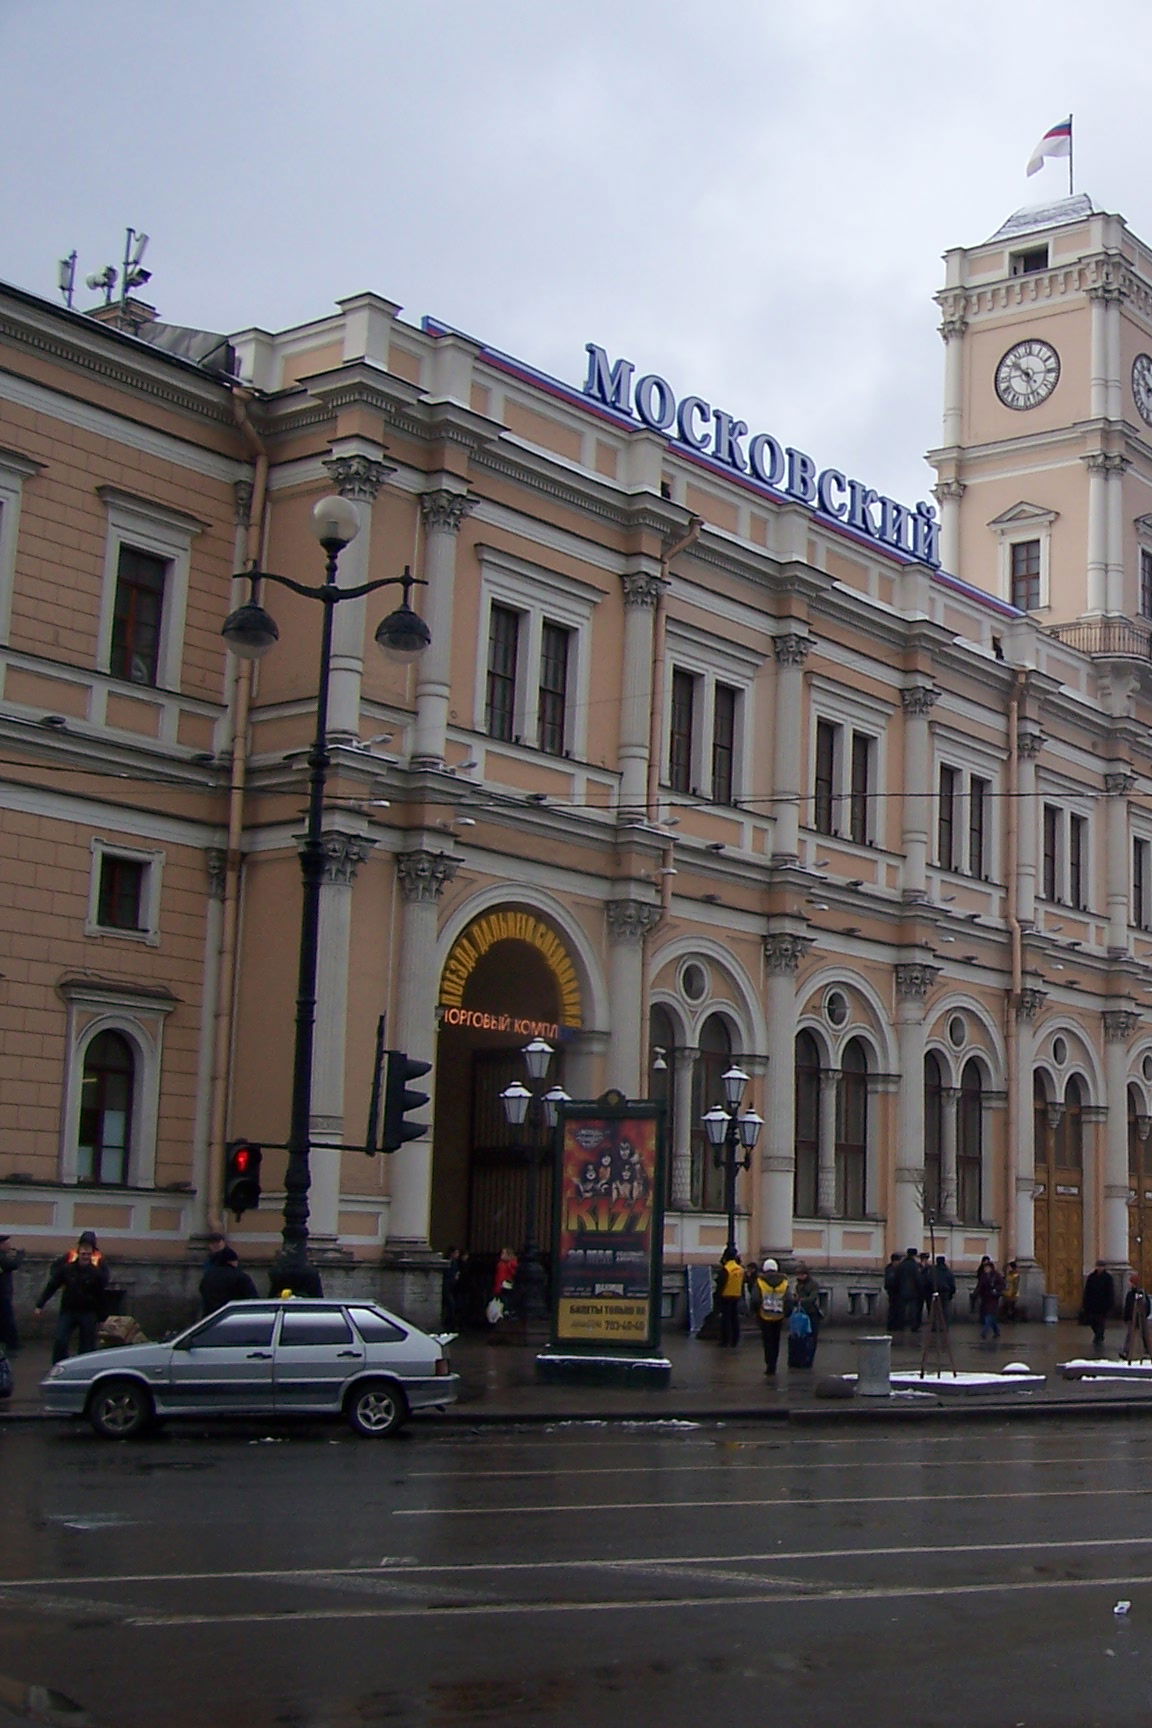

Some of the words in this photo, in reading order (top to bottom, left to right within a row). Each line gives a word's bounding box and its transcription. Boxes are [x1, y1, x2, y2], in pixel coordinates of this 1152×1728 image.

[584, 342, 942, 568] МОСКОВСКИЙ
[441, 937, 479, 1008] ПОЕЗДА
[567, 1199, 651, 1231] KISS
